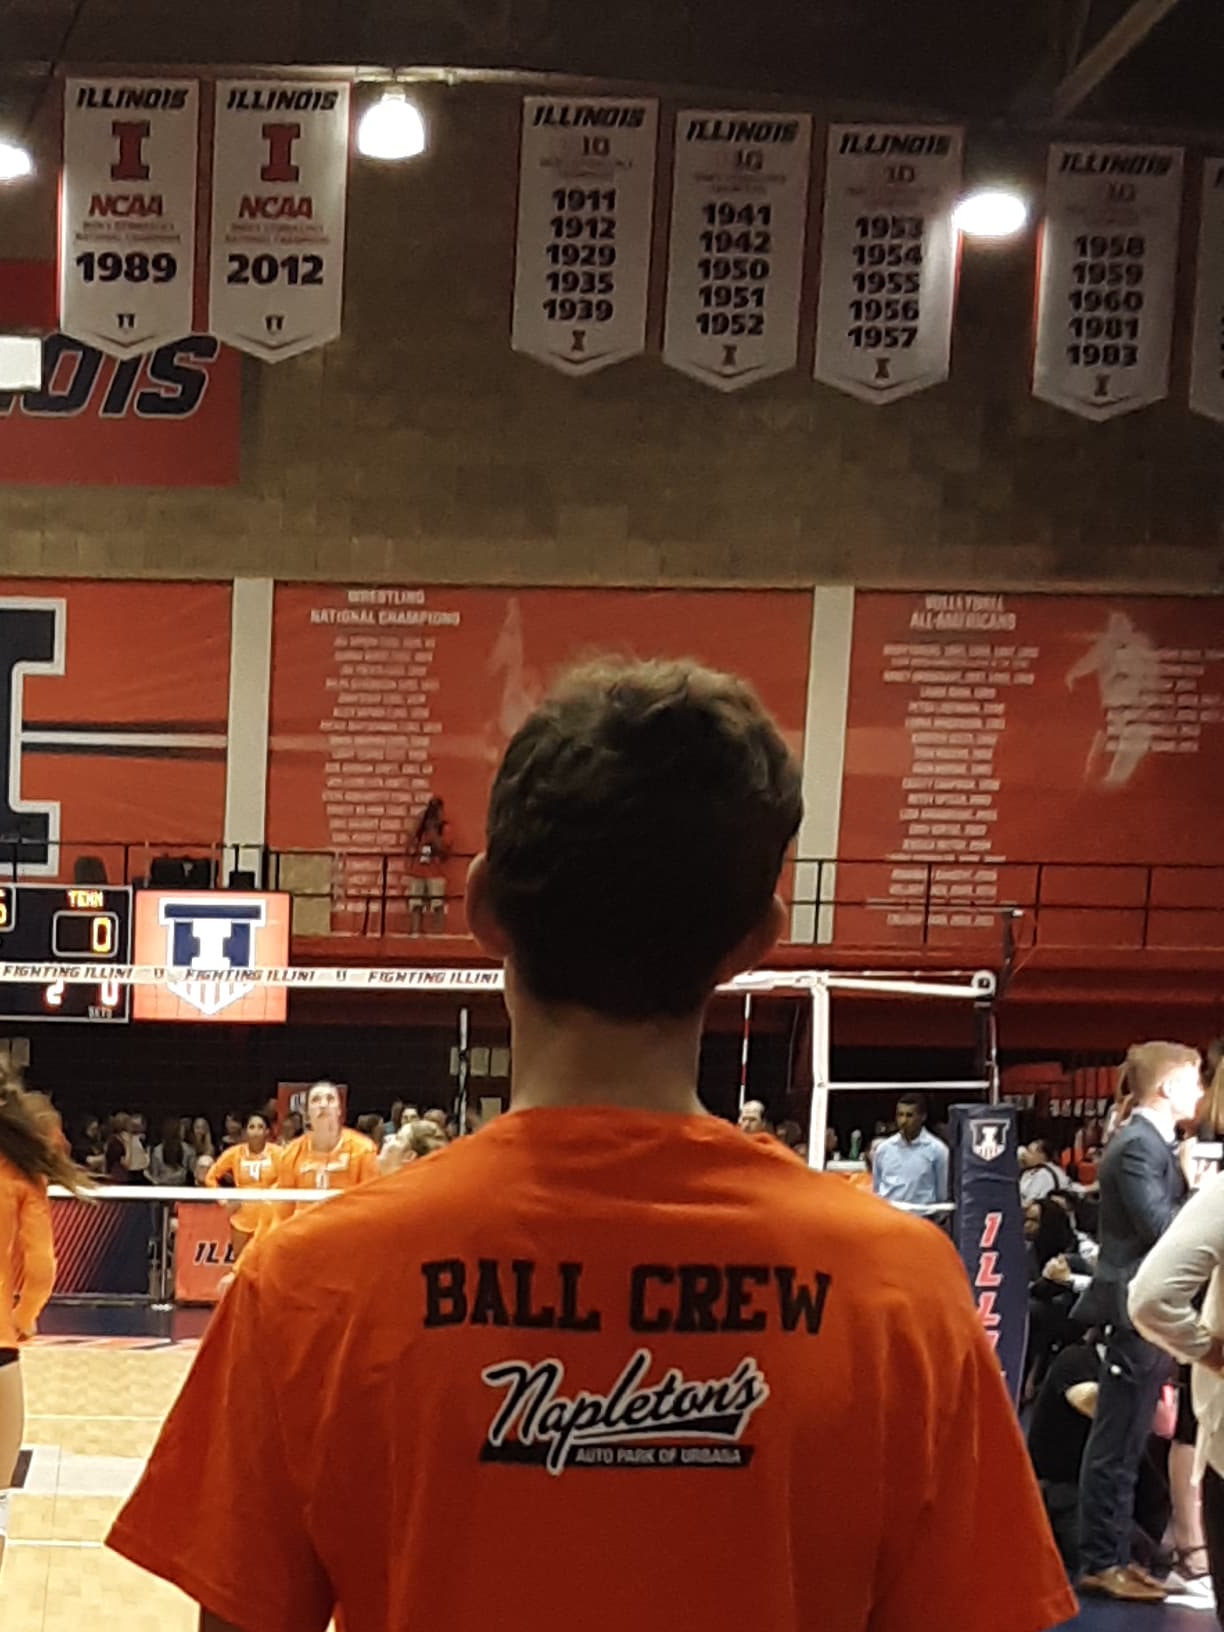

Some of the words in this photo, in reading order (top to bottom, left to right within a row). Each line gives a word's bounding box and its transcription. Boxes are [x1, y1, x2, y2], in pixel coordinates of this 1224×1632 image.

[76, 87, 189, 111] ILLINOIS
[226, 89, 340, 112] ILLINOIS
[532, 105, 646, 128] ILLINOIS
[687, 119, 799, 143] ILLINOIS
[839, 133, 953, 156] ILLINOIS
[1060, 151, 1173, 176] ILLINOIS
[88, 194, 163, 217] NCAA
[238, 196, 313, 220] NCAA
[552, 188, 616, 212] 1911
[702, 203, 771, 226] 1941
[550, 216, 616, 240] 1912
[855, 216, 924, 239] 1953
[700, 230, 771, 254] 1942
[76, 252, 177, 283] 1989
[546, 244, 616, 267] 1929
[852, 244, 923, 267] 1954
[227, 254, 324, 285] 2012
[697, 258, 770, 280] 1950
[545, 270, 614, 295] 1935
[852, 271, 920, 295] 1955
[543, 297, 614, 322] 1939
[698, 285, 765, 310] 1951
[848, 299, 920, 323] 1956
[696, 312, 764, 336] 1952
[847, 325, 918, 350] 1957
[92, 916, 112, 952] 0
[2, 964, 80, 978] FIGHTING
[84, 967, 133, 979] ILLINI
[185, 968, 262, 982] FIGHTING
[267, 970, 315, 982] ILLINI
[368, 970, 445, 983] FIGHTING
[450, 972, 499, 985] ILLINI
[421, 1258, 601, 1332] BALL
[629, 1263, 832, 1336] CREW
[481, 1348, 770, 1476] Napleton's
[576, 1447, 613, 1463] AUTO
[617, 1447, 655, 1463] PARK
[659, 1448, 677, 1463] OF
[681, 1448, 741, 1463] URBANA
